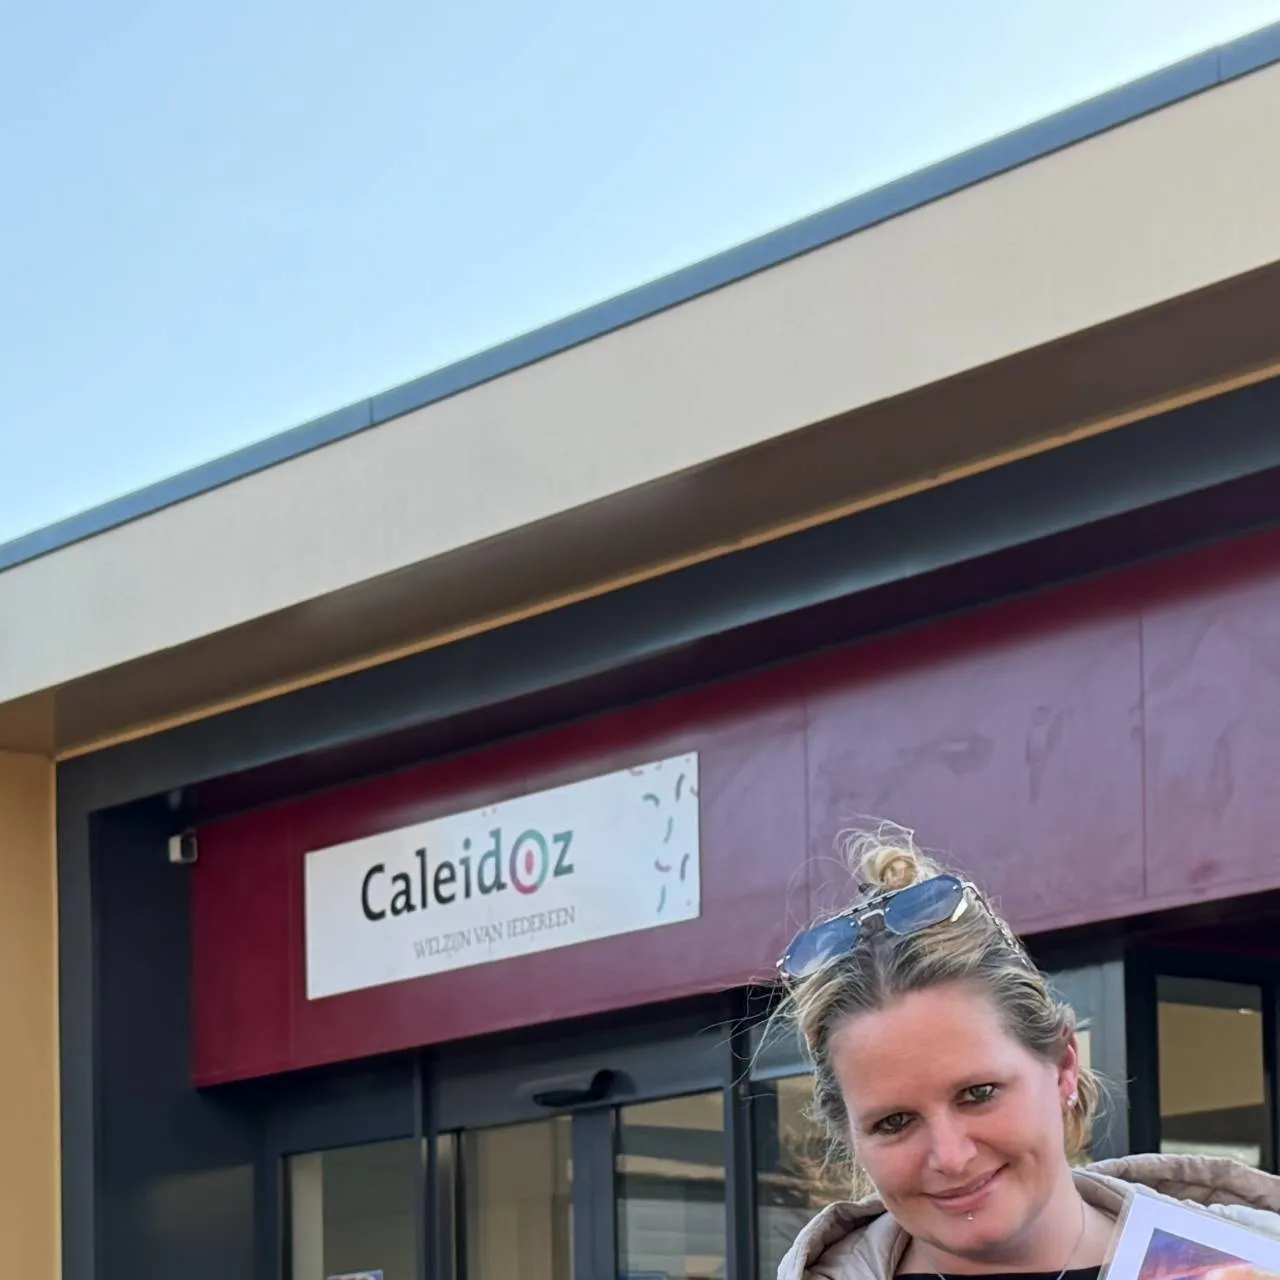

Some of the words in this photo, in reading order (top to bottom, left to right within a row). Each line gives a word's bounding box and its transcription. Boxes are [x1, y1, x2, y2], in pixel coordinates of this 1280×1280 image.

[413, 928, 472, 959] WELZIJN
[473, 921, 503, 946] VAN
[506, 905, 575, 940] IEDEREEN
